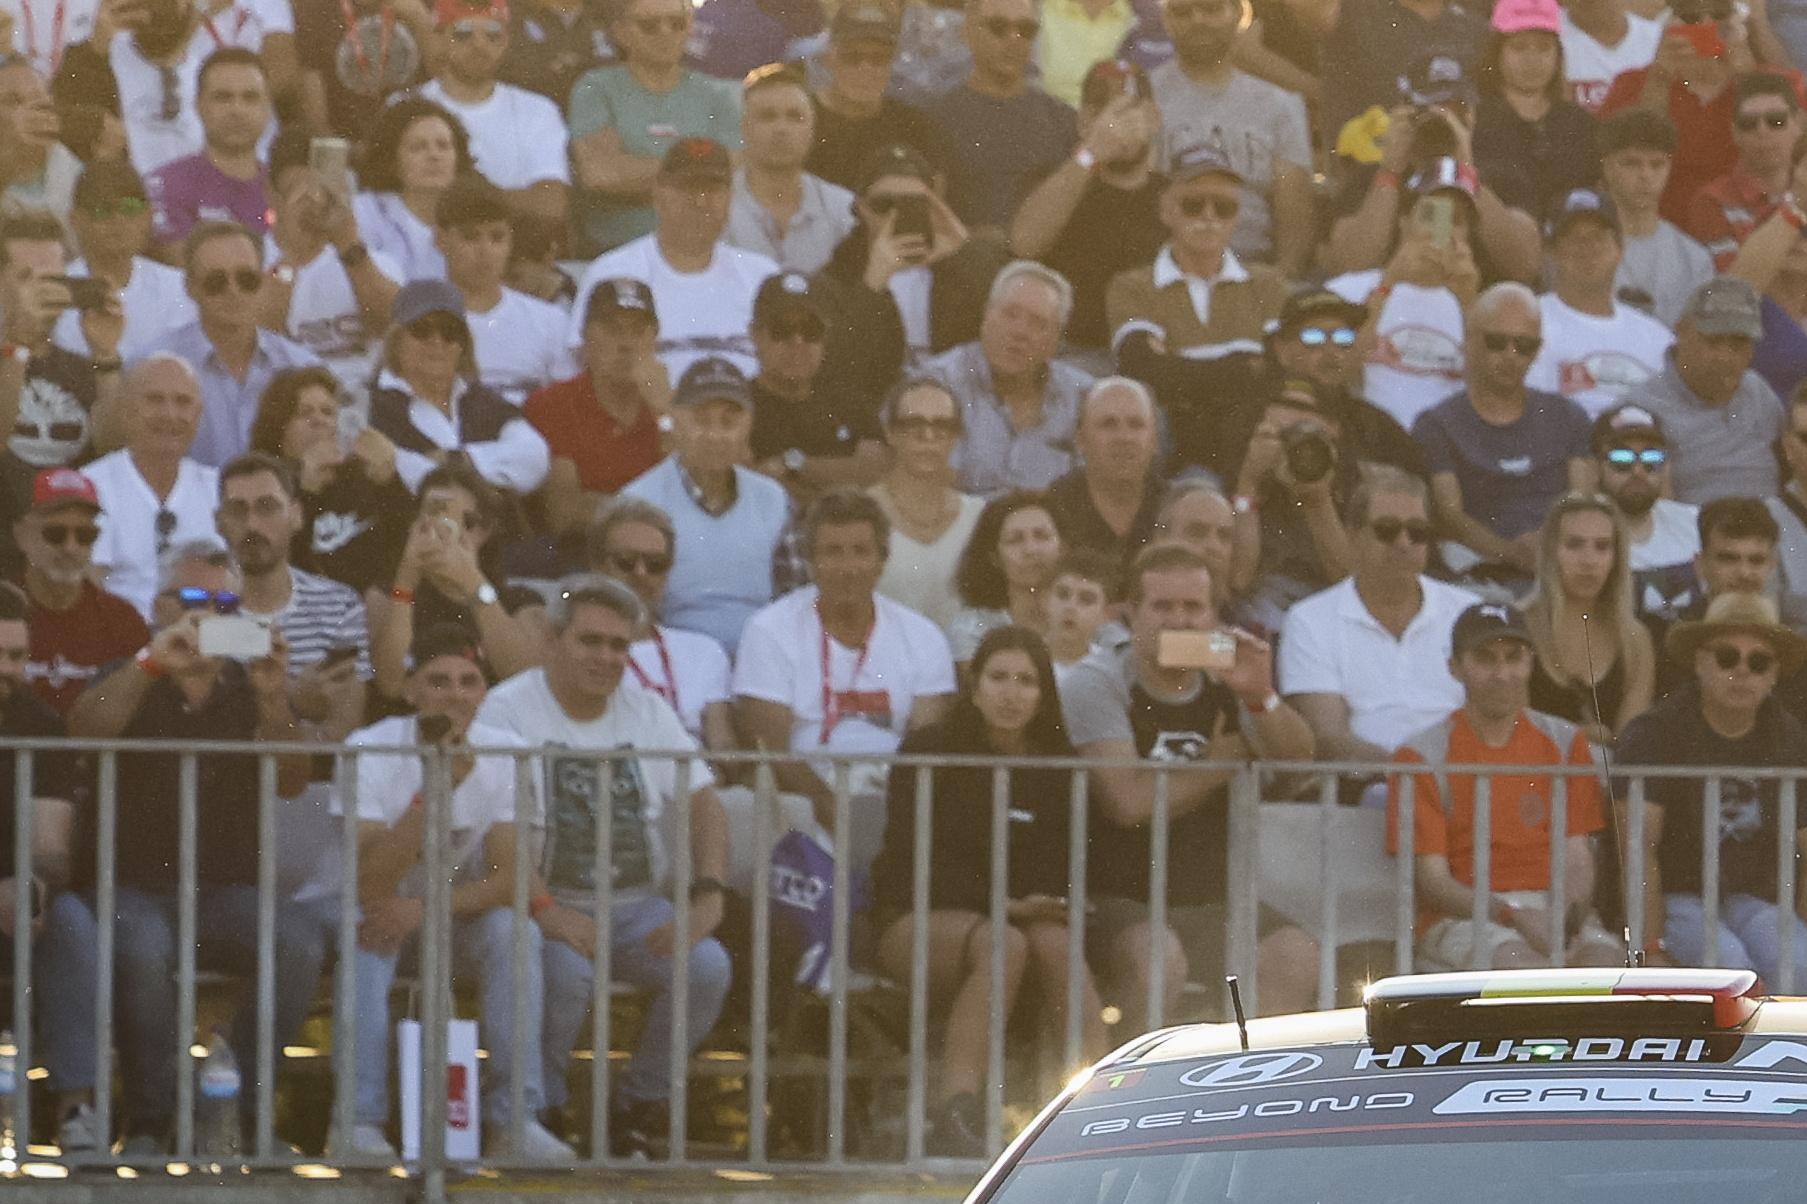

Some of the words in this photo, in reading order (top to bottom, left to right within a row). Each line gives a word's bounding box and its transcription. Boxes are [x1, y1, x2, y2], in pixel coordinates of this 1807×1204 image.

[1354, 1038, 1706, 1070] HYUNDAI
[1081, 1092, 1415, 1136] BEYOND
[1484, 1087, 1752, 1103] RALLY
